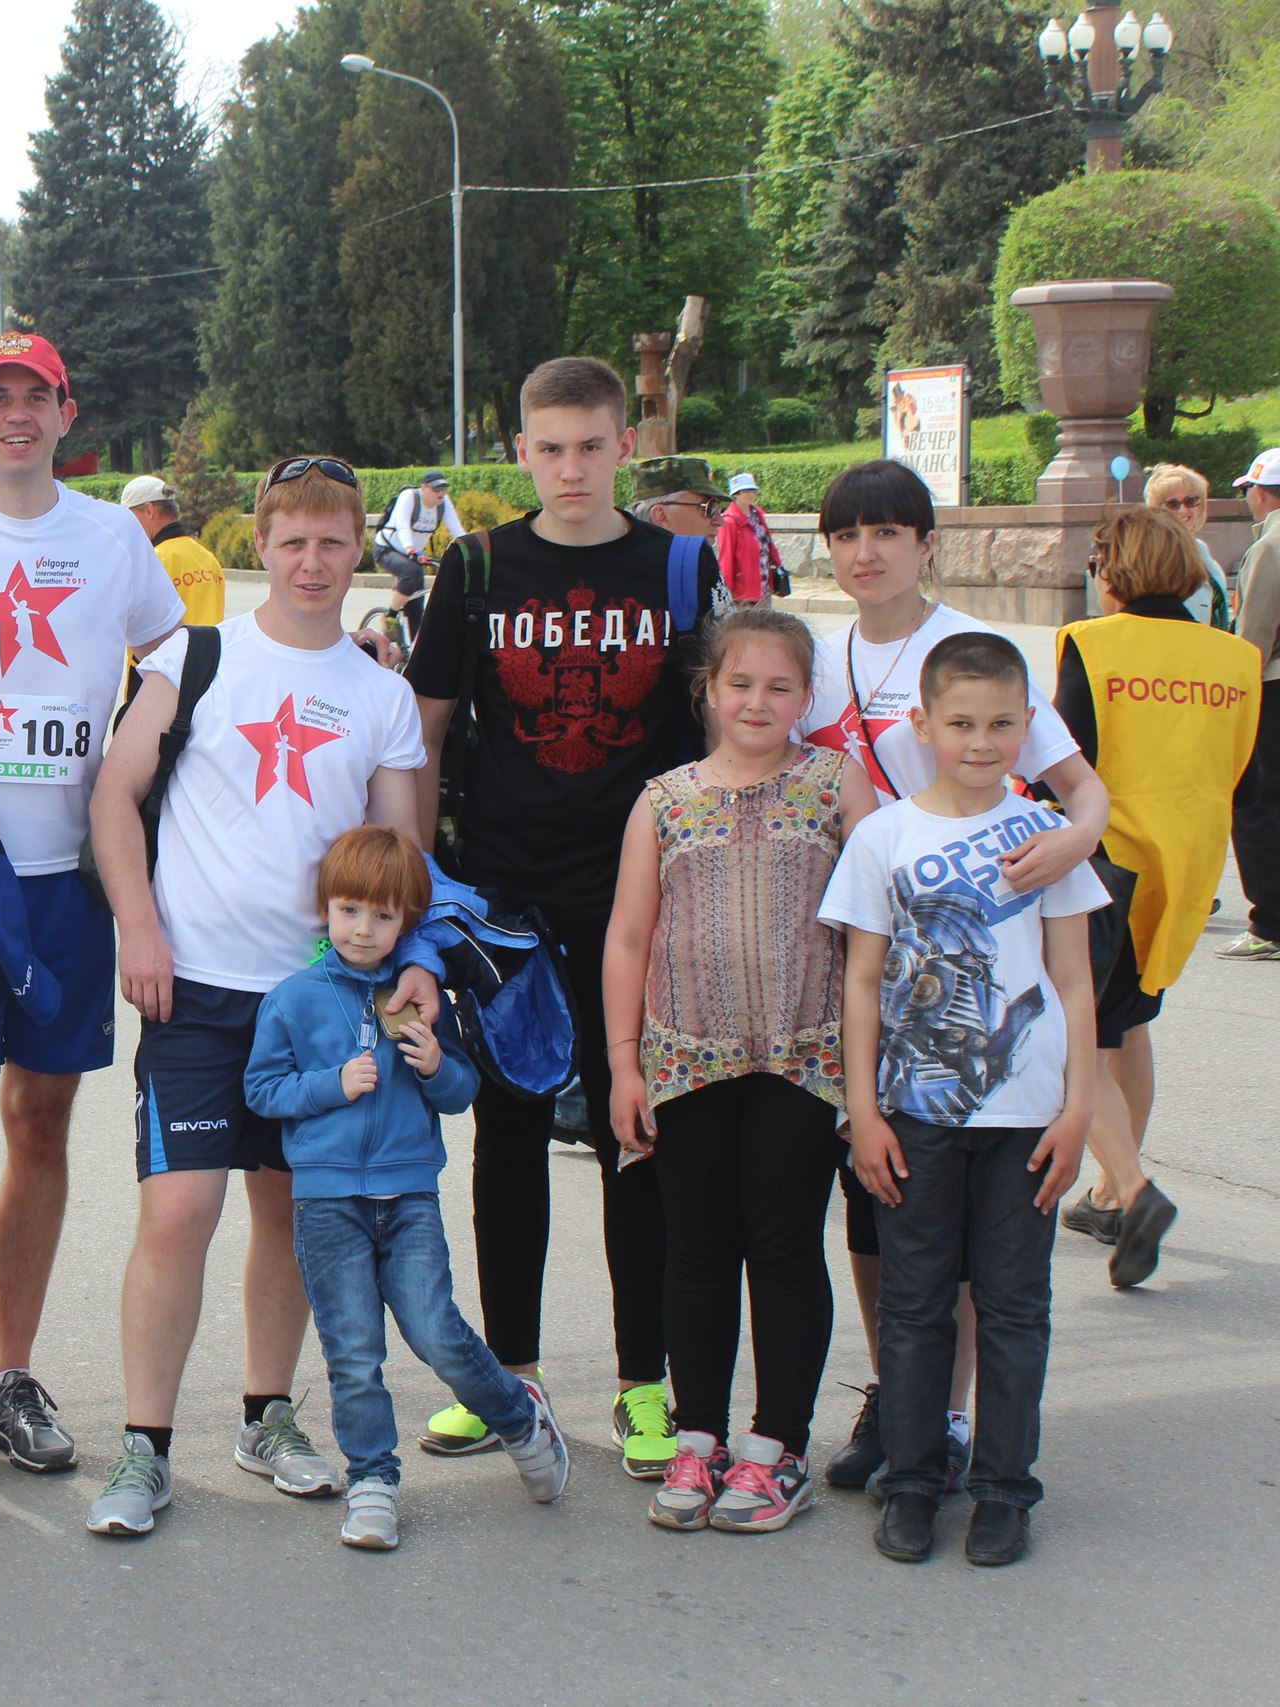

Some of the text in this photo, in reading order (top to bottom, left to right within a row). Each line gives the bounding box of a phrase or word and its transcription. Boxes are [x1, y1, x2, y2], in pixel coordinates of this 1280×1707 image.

[909, 430, 956, 451] ВЕЧЕР
[891, 453, 958, 474] ОМАНСА
[35, 556, 80, 569] Volgograd
[488, 609, 671, 652] ПОБЕДА!
[1106, 677, 1247, 711] РОССПОРТ
[41, 705, 68, 713] ПРОФИЛЬ
[303, 707, 340, 724] International
[306, 695, 349, 717] Volgograd
[300, 714, 351, 737] Marathon 2015
[22, 719, 91, 758] 10.8
[913, 807, 1063, 888] OPTIMU
[170, 1119, 228, 1132] GIVOVA
